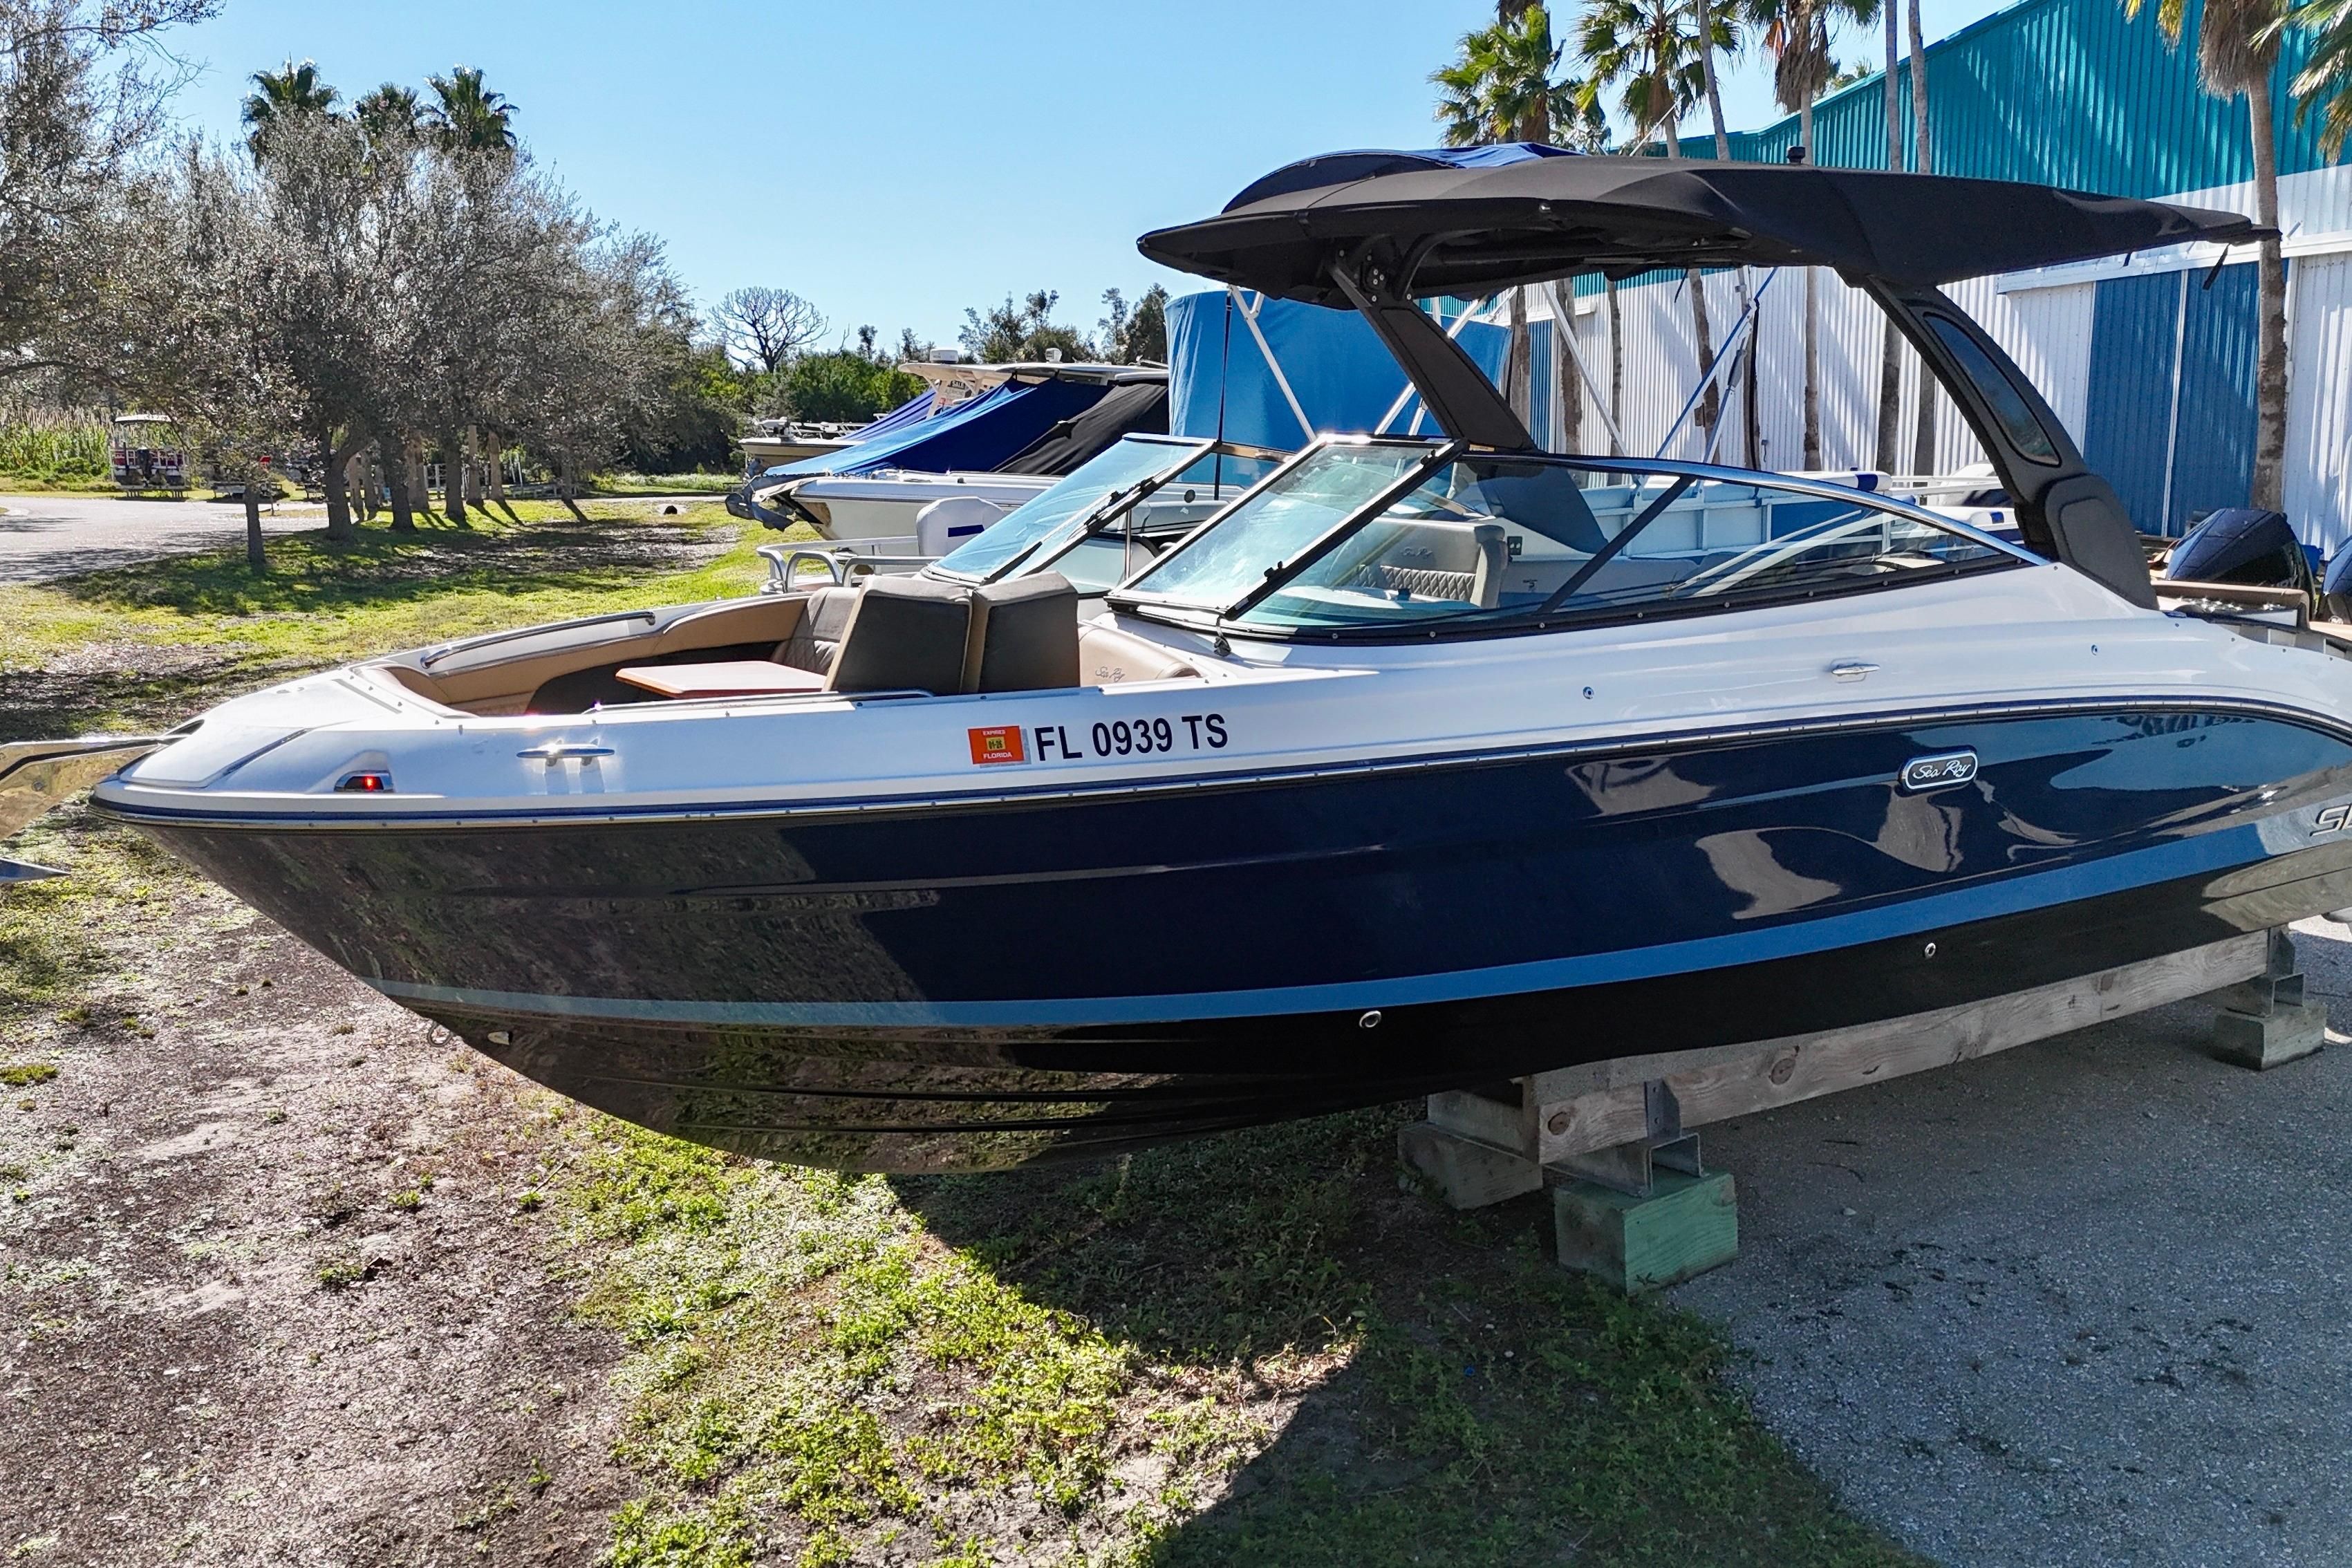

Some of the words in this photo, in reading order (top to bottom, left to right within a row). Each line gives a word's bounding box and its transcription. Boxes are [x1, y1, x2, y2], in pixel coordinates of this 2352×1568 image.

[1034, 726, 1083, 761] FL
[1092, 718, 1173, 757] 0939
[1182, 713, 1228, 750] TS
[983, 752, 1013, 760] FLORIDA
[1912, 765, 1941, 780] Sea
[1942, 760, 1972, 778] Ray
